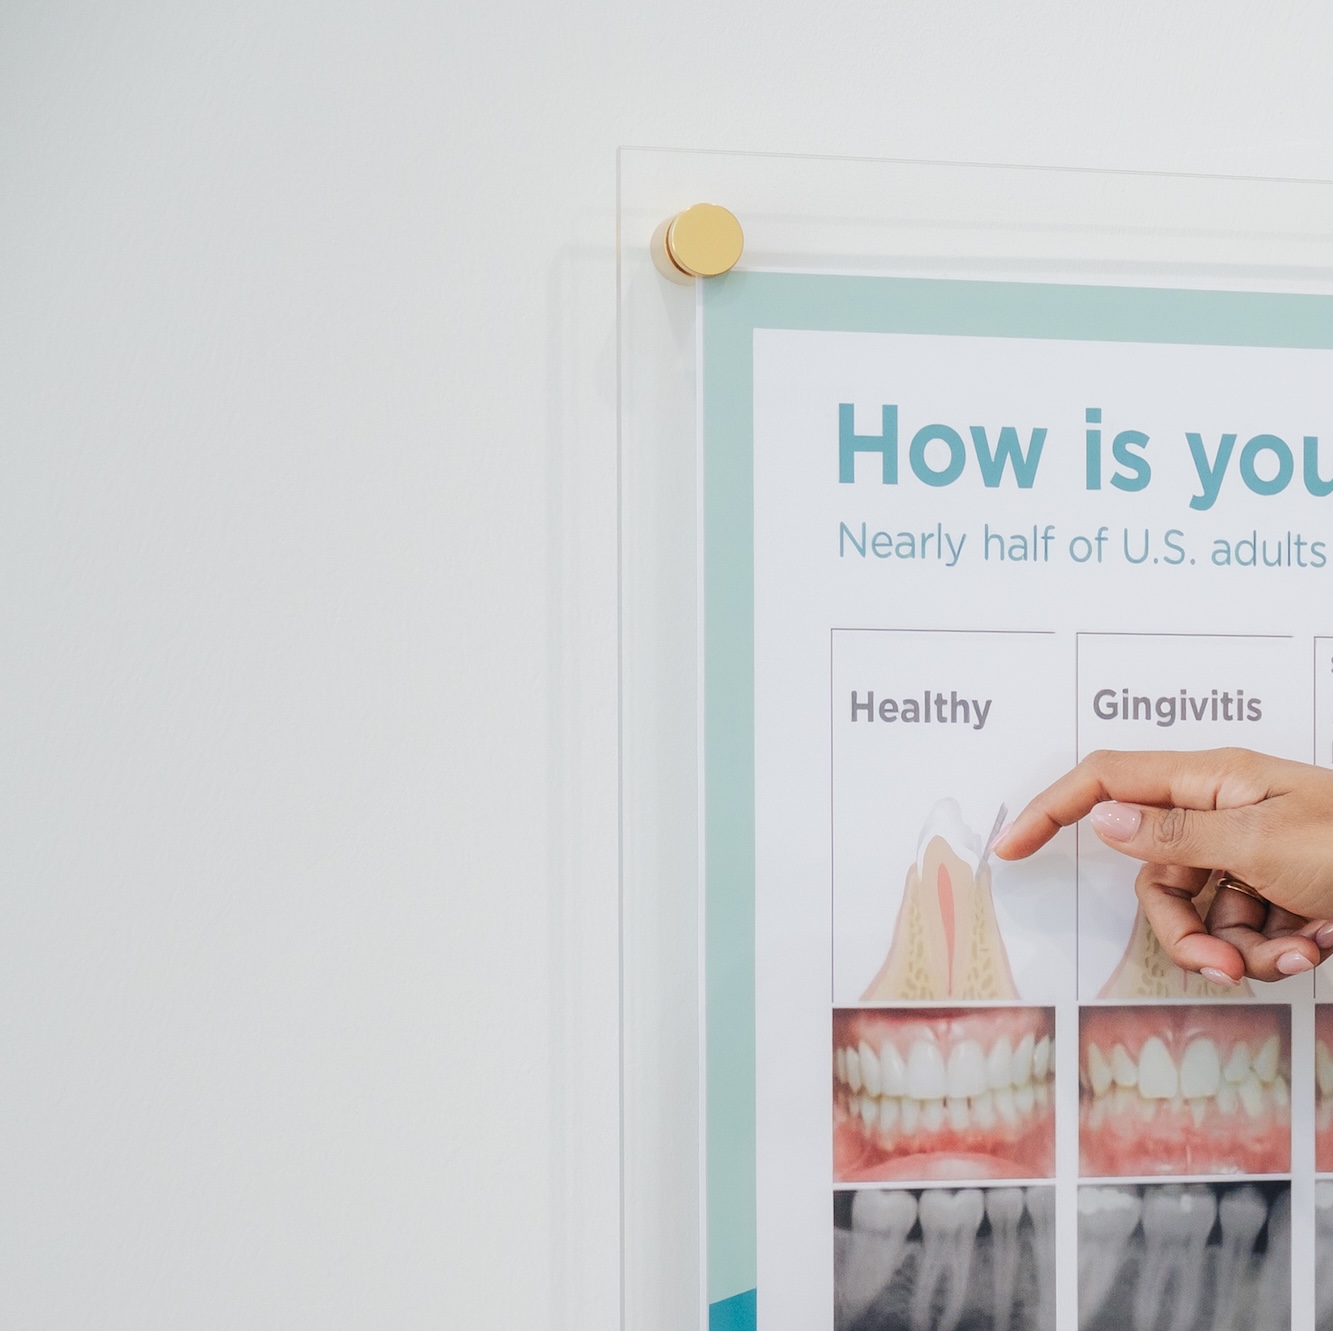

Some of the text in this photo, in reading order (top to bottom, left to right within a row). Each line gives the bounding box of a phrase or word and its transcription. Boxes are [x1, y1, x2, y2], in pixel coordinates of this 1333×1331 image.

[839, 403, 1048, 488] How
[1086, 408, 1151, 492] is
[840, 522, 966, 567] Nearly
[985, 524, 1055, 562] half
[1069, 527, 1108, 563] of
[1124, 528, 1195, 565] U.S.
[1212, 530, 1326, 567] adults
[851, 691, 992, 730] Healthy
[1093, 688, 1262, 727] Gingivitis
